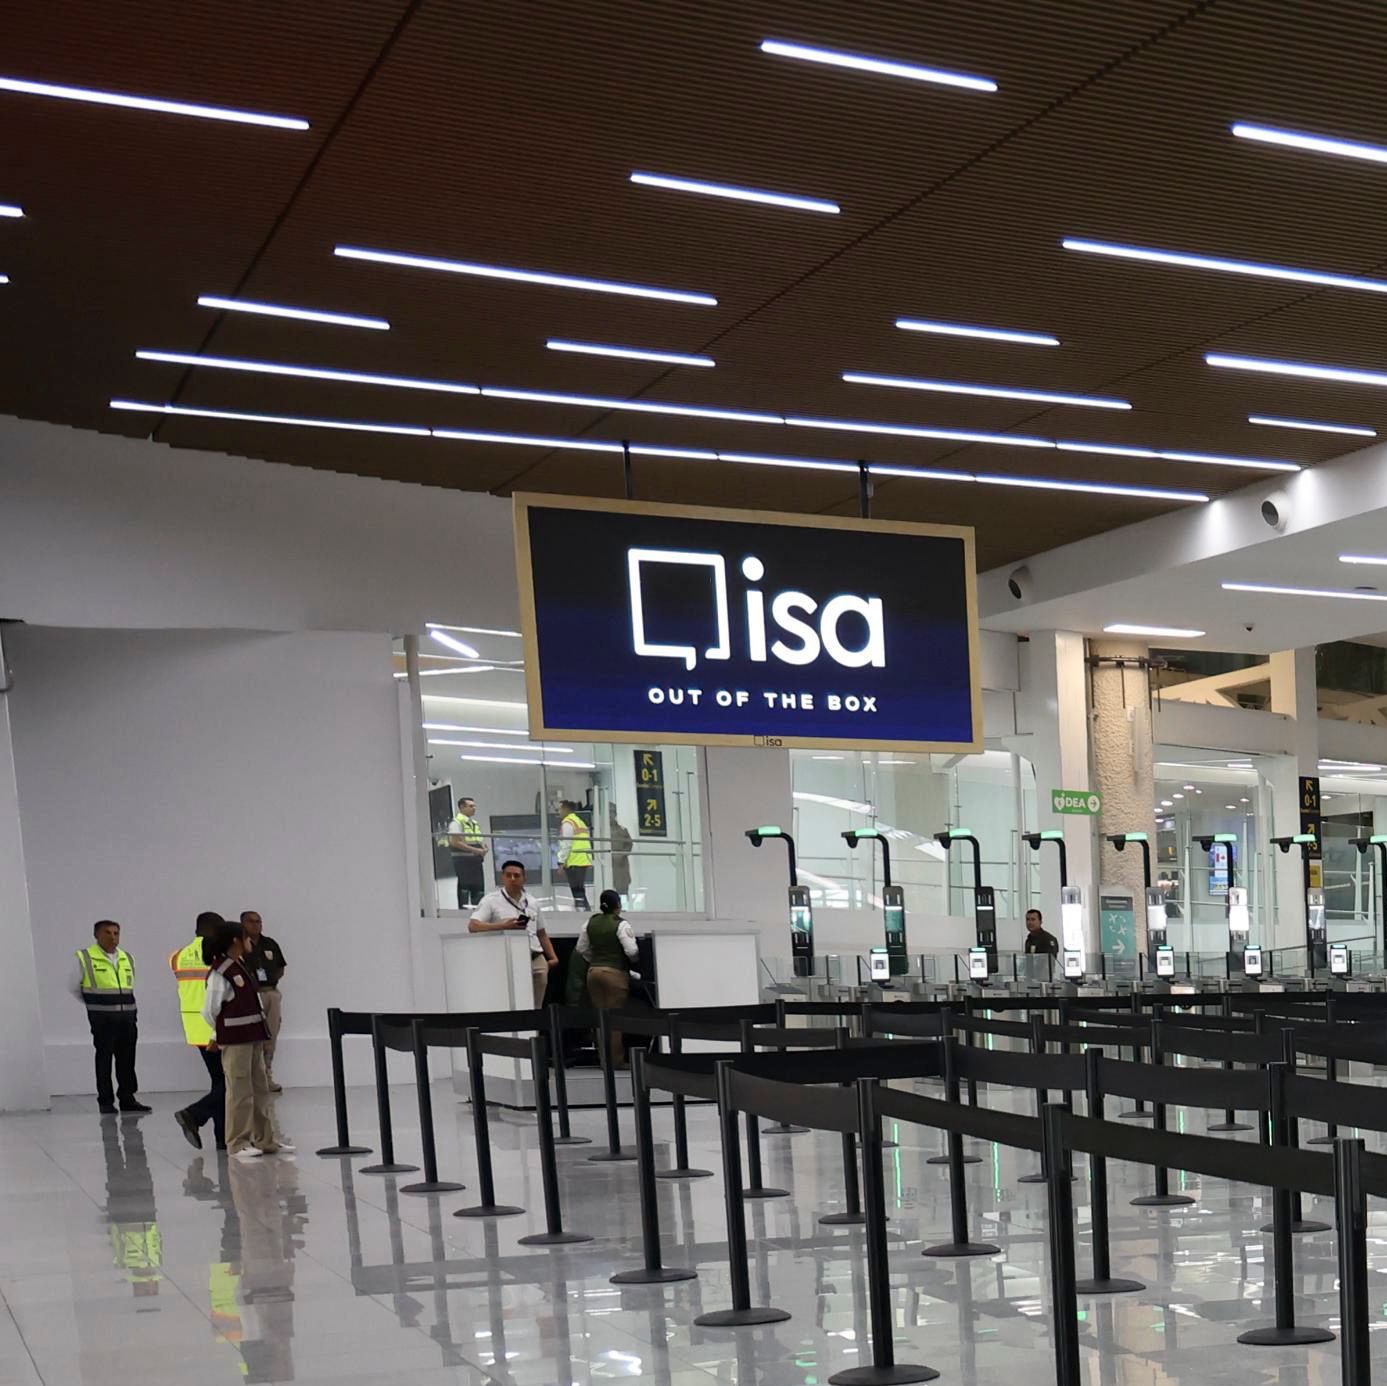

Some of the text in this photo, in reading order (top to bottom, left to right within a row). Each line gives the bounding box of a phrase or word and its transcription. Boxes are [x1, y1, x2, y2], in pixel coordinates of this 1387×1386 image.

[741, 556, 886, 668] isa
[648, 687, 878, 713] OUT OF THE BOX
[766, 735, 782, 747] isa
[641, 768, 658, 782] 0-1
[1065, 797, 1087, 809] DEA
[1304, 794, 1316, 807] 0-1
[643, 813, 661, 827] 2-5
